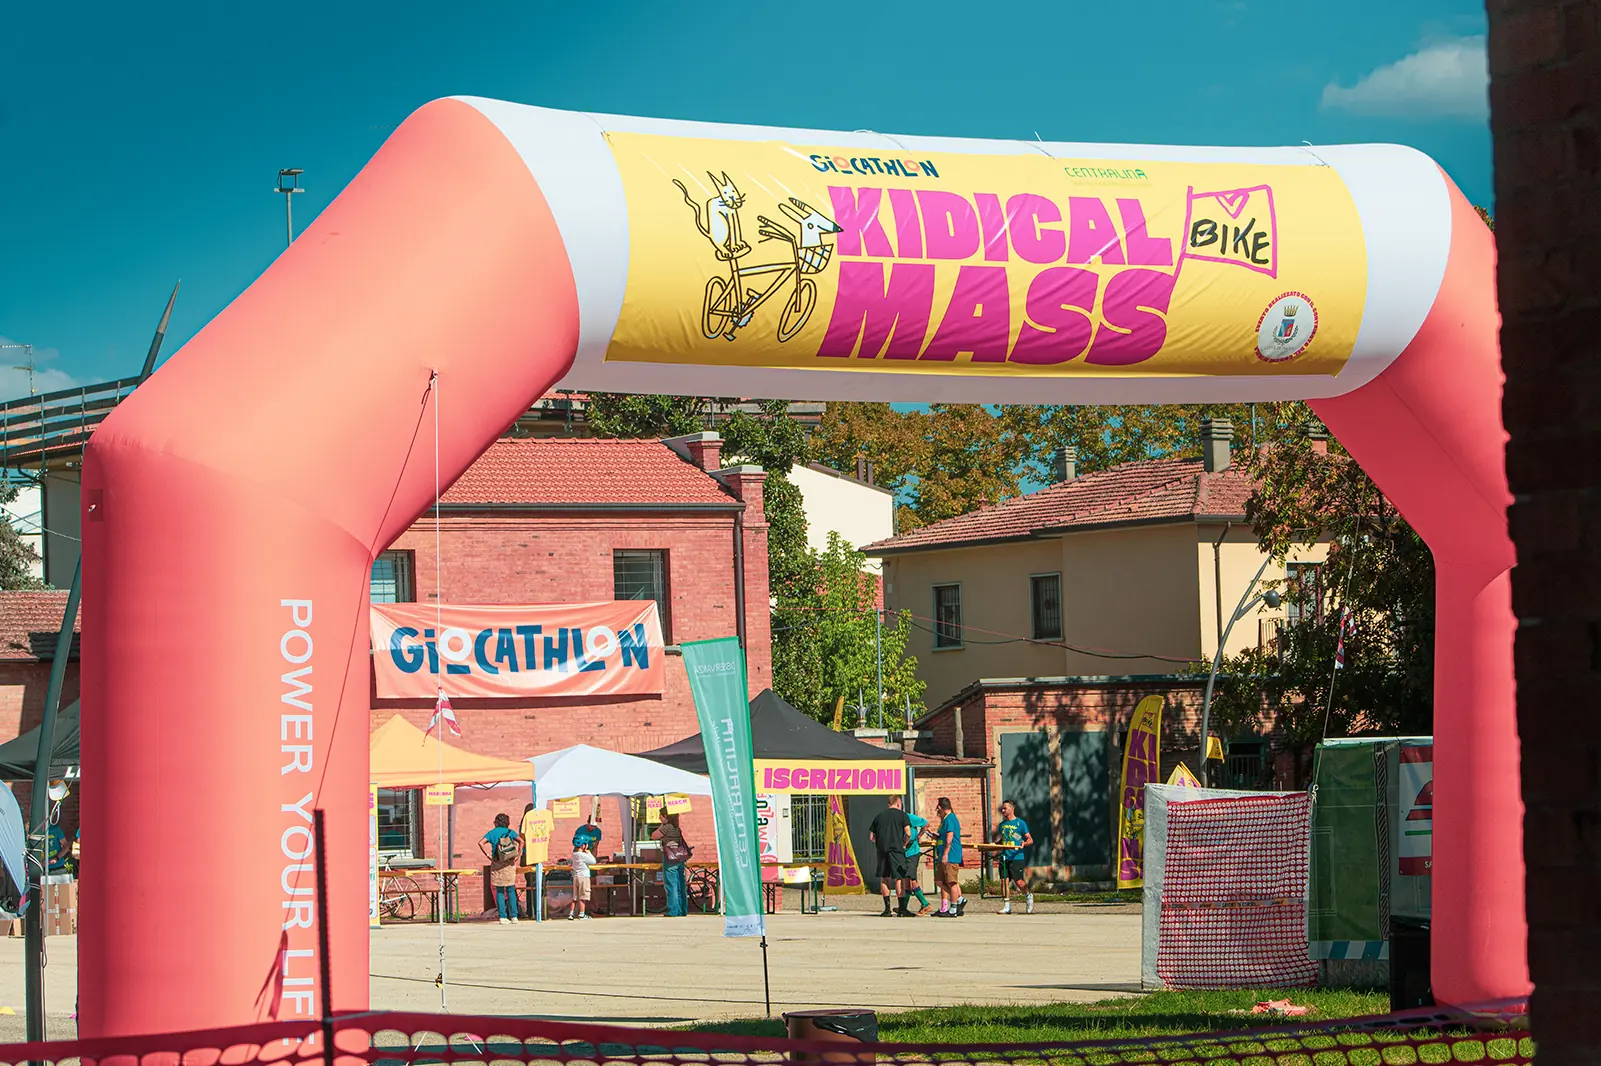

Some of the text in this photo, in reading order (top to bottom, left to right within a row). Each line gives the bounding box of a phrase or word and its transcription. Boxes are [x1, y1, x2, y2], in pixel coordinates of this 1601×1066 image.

[1064, 167, 1148, 179] CENTRALINA
[827, 186, 1173, 266] KIDICAL
[1190, 218, 1269, 264] BIKE
[816, 261, 1175, 365] MASS
[280, 599, 313, 776] POWER
[763, 768, 902, 790] ISCRIZIONI
[281, 791, 314, 931] YOUR
